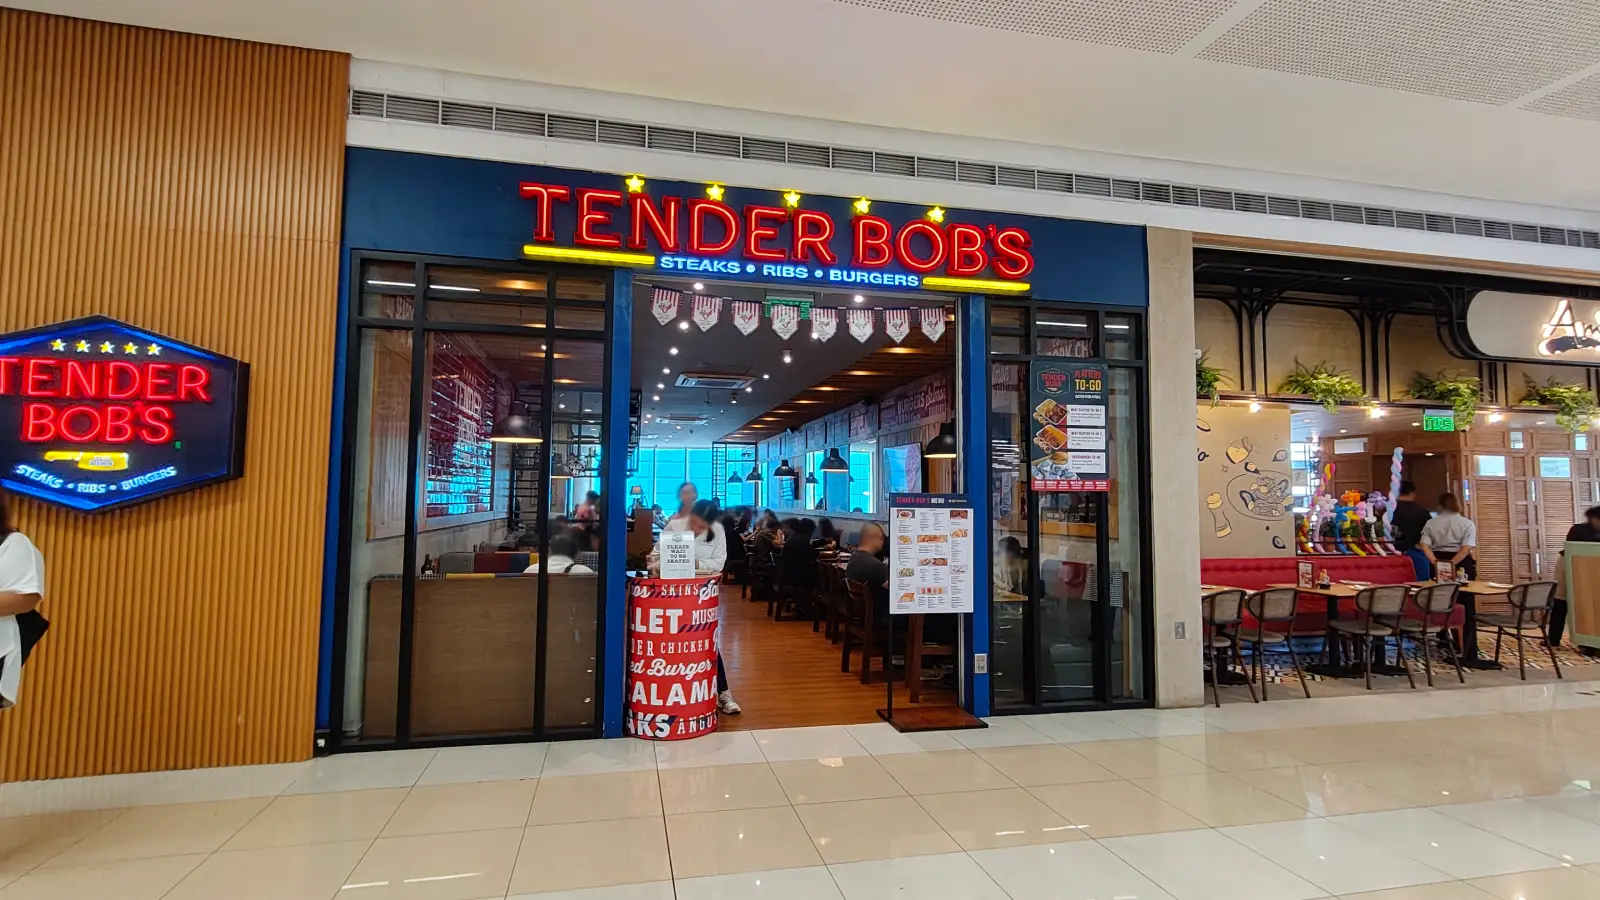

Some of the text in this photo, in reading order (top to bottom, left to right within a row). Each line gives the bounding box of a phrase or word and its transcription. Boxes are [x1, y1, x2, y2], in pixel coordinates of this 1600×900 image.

[519, 181, 1035, 280] TENDER BOB'S
[660, 256, 920, 288] STEAKS RIBS BURGERS
[0, 355, 212, 402] TENDER
[1074, 379, 1102, 391] TO-GO
[21, 401, 175, 443] BOB'S
[15, 464, 178, 494] STEAKS RIBS BURGERS
[631, 585, 651, 598] os
[661, 583, 700, 596] SKINS
[660, 639, 710, 654] CHICKEN
[647, 658, 712, 681] Burger
